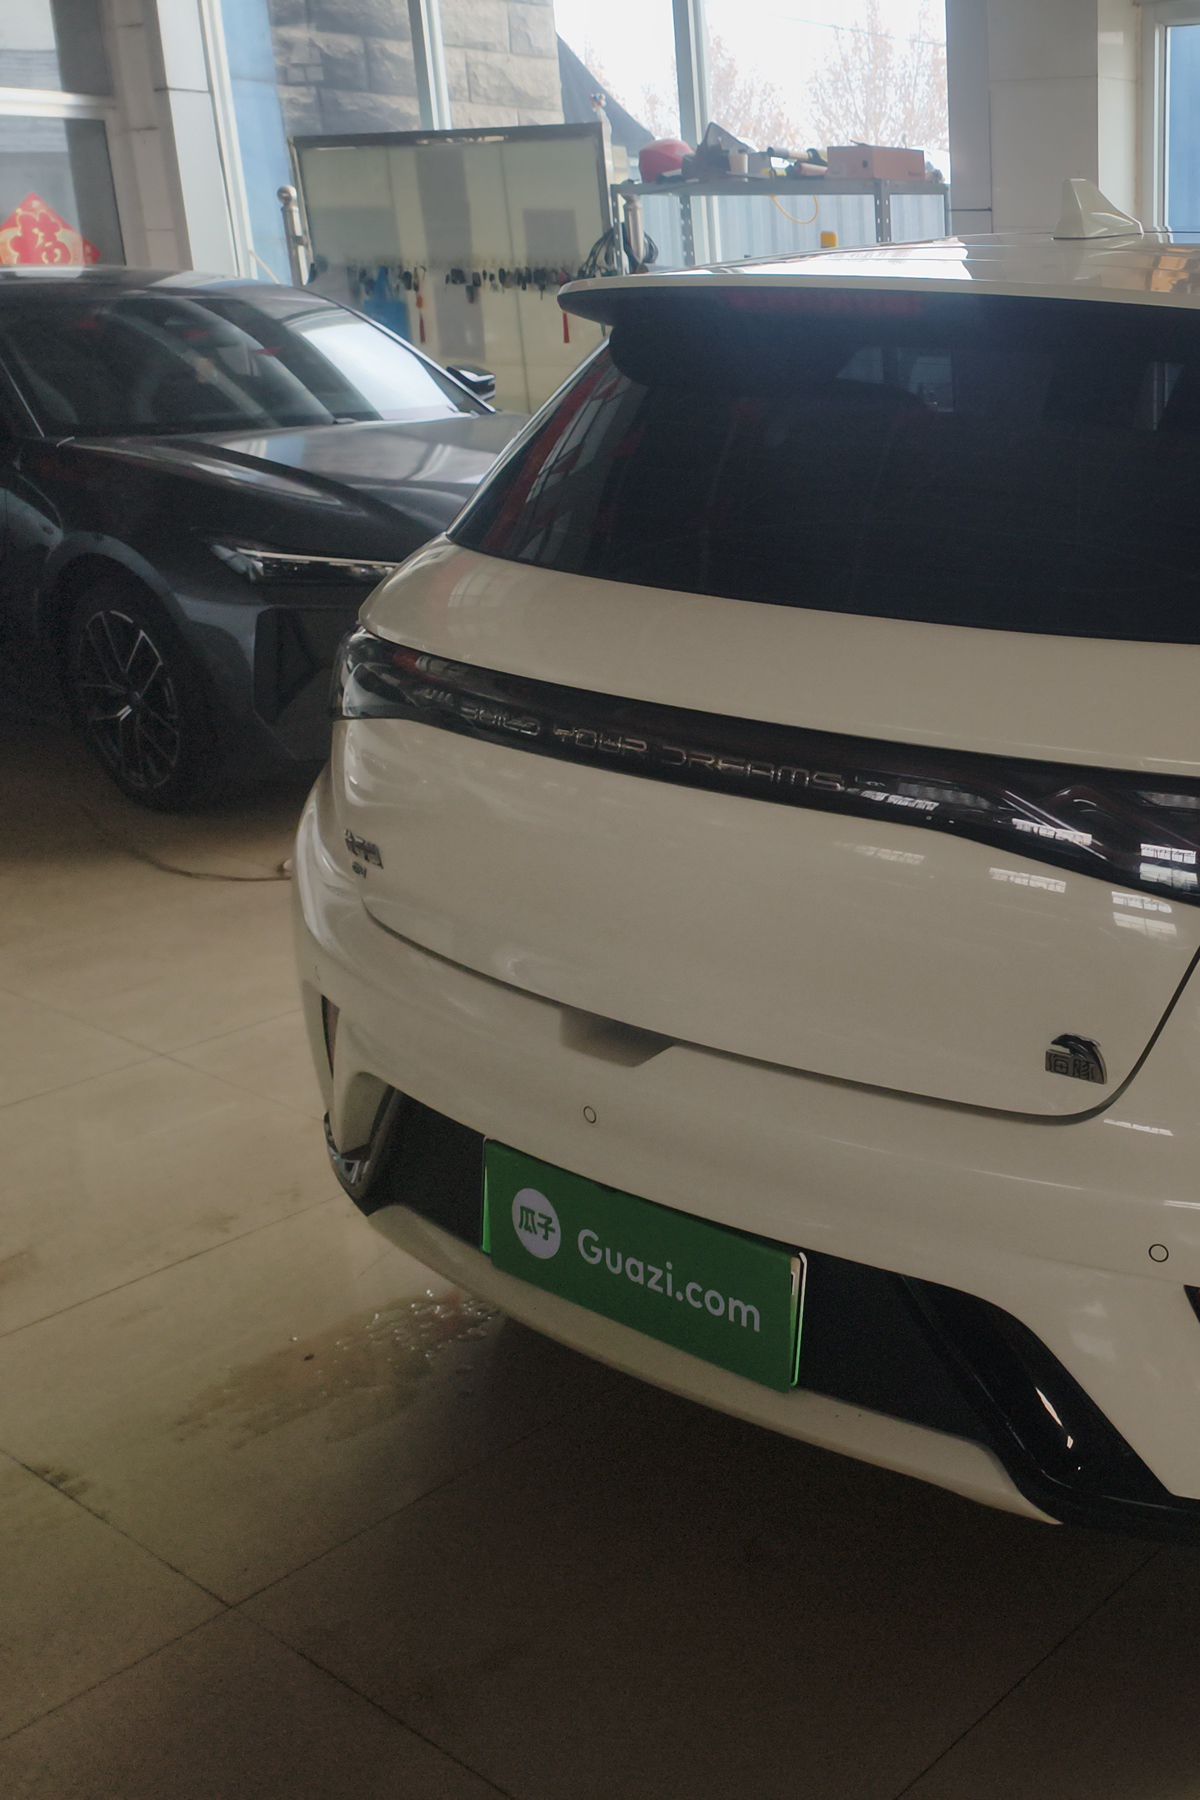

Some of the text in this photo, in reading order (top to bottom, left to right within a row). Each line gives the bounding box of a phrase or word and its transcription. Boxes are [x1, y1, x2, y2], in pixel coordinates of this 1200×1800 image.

[553, 723, 648, 759] YOUR
[660, 744, 845, 792] DREAMS
[518, 1205, 556, 1241] 瓜子
[577, 1228, 761, 1332] Guazi.com
